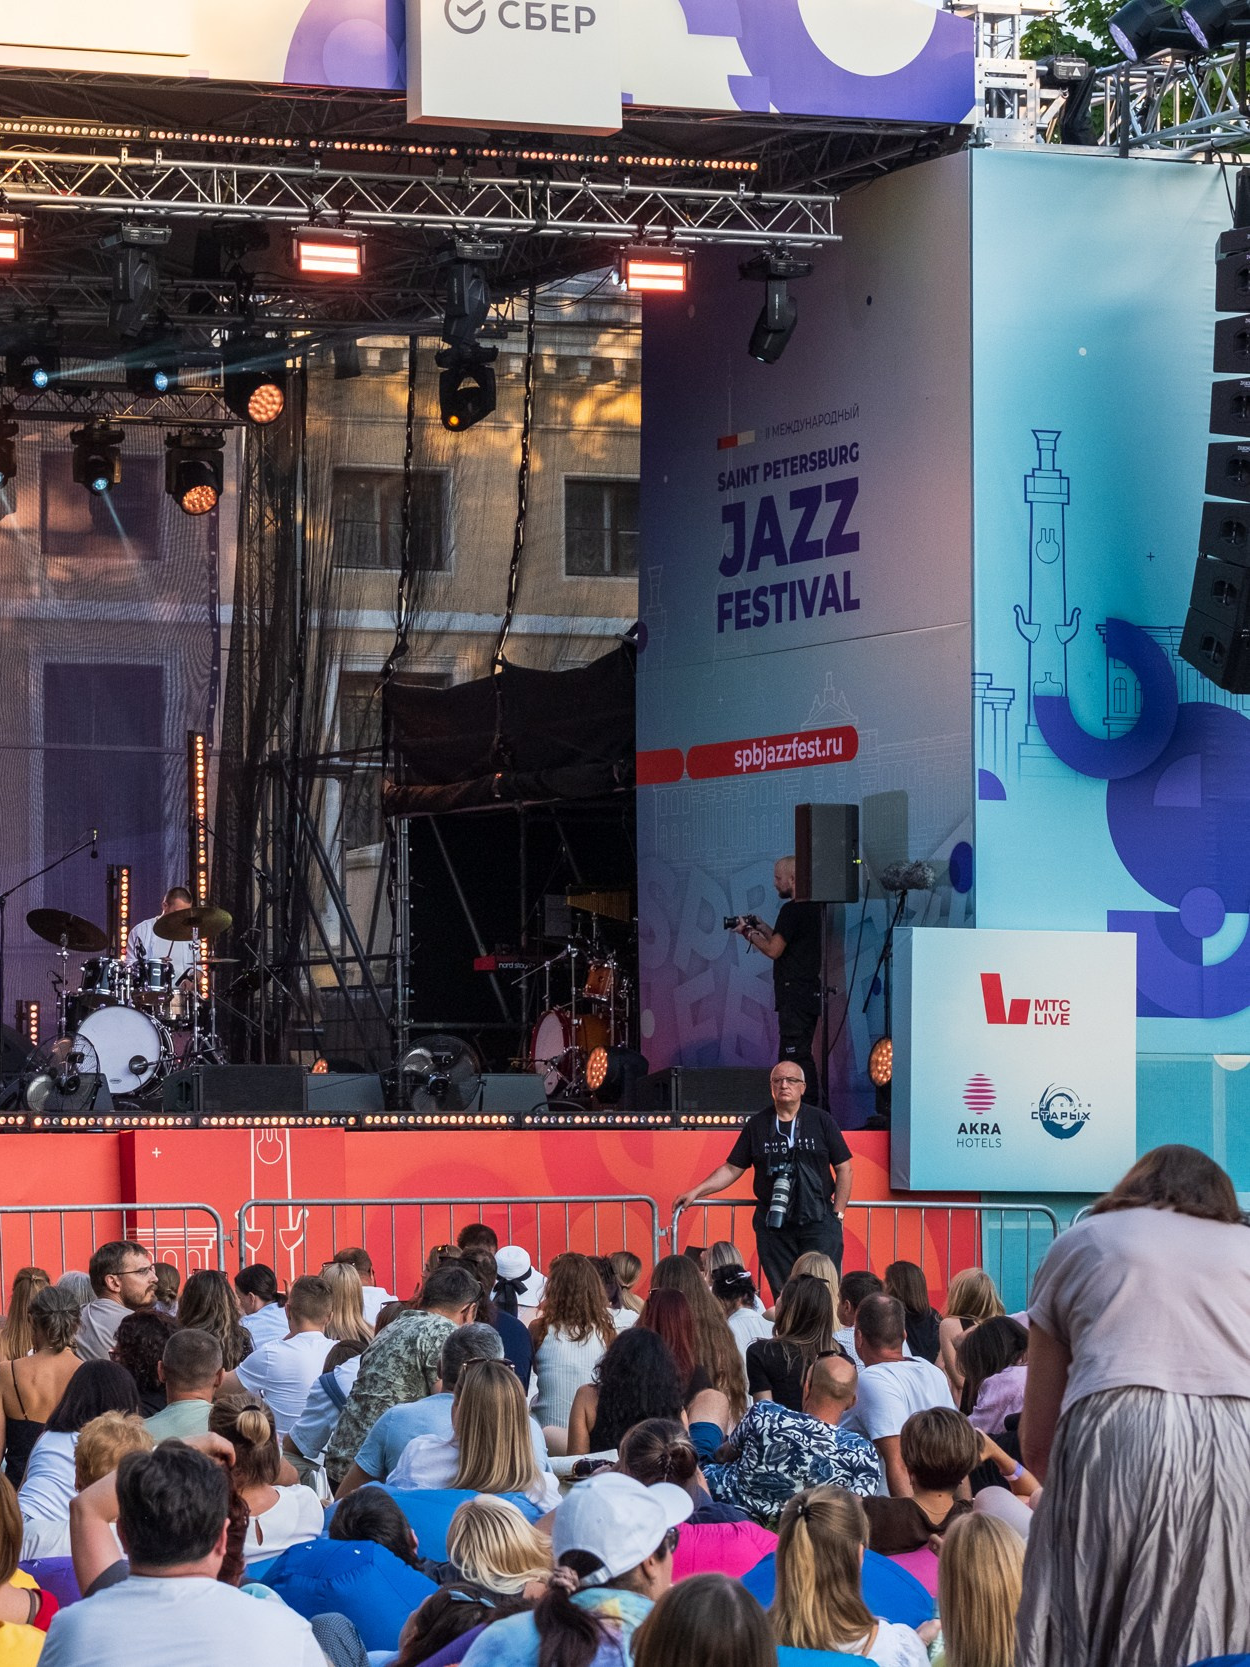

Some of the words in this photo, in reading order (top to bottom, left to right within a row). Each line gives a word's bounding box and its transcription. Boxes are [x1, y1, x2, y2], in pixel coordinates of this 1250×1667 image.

[498, 0, 596, 34] СБЕР
[772, 403, 860, 438] МЕЖДУНАРОДНЫЙ
[717, 463, 760, 492] SAINT
[763, 442, 860, 482] PETERSBURG
[718, 476, 860, 578] JAZZ
[717, 570, 861, 634] FESTIVAL
[734, 736, 843, 772] spbjazzfest.ru
[1034, 1013, 1070, 1026] LIVE
[956, 1138, 1002, 1148] HOTELS
[957, 1122, 1002, 1135] AKRA
